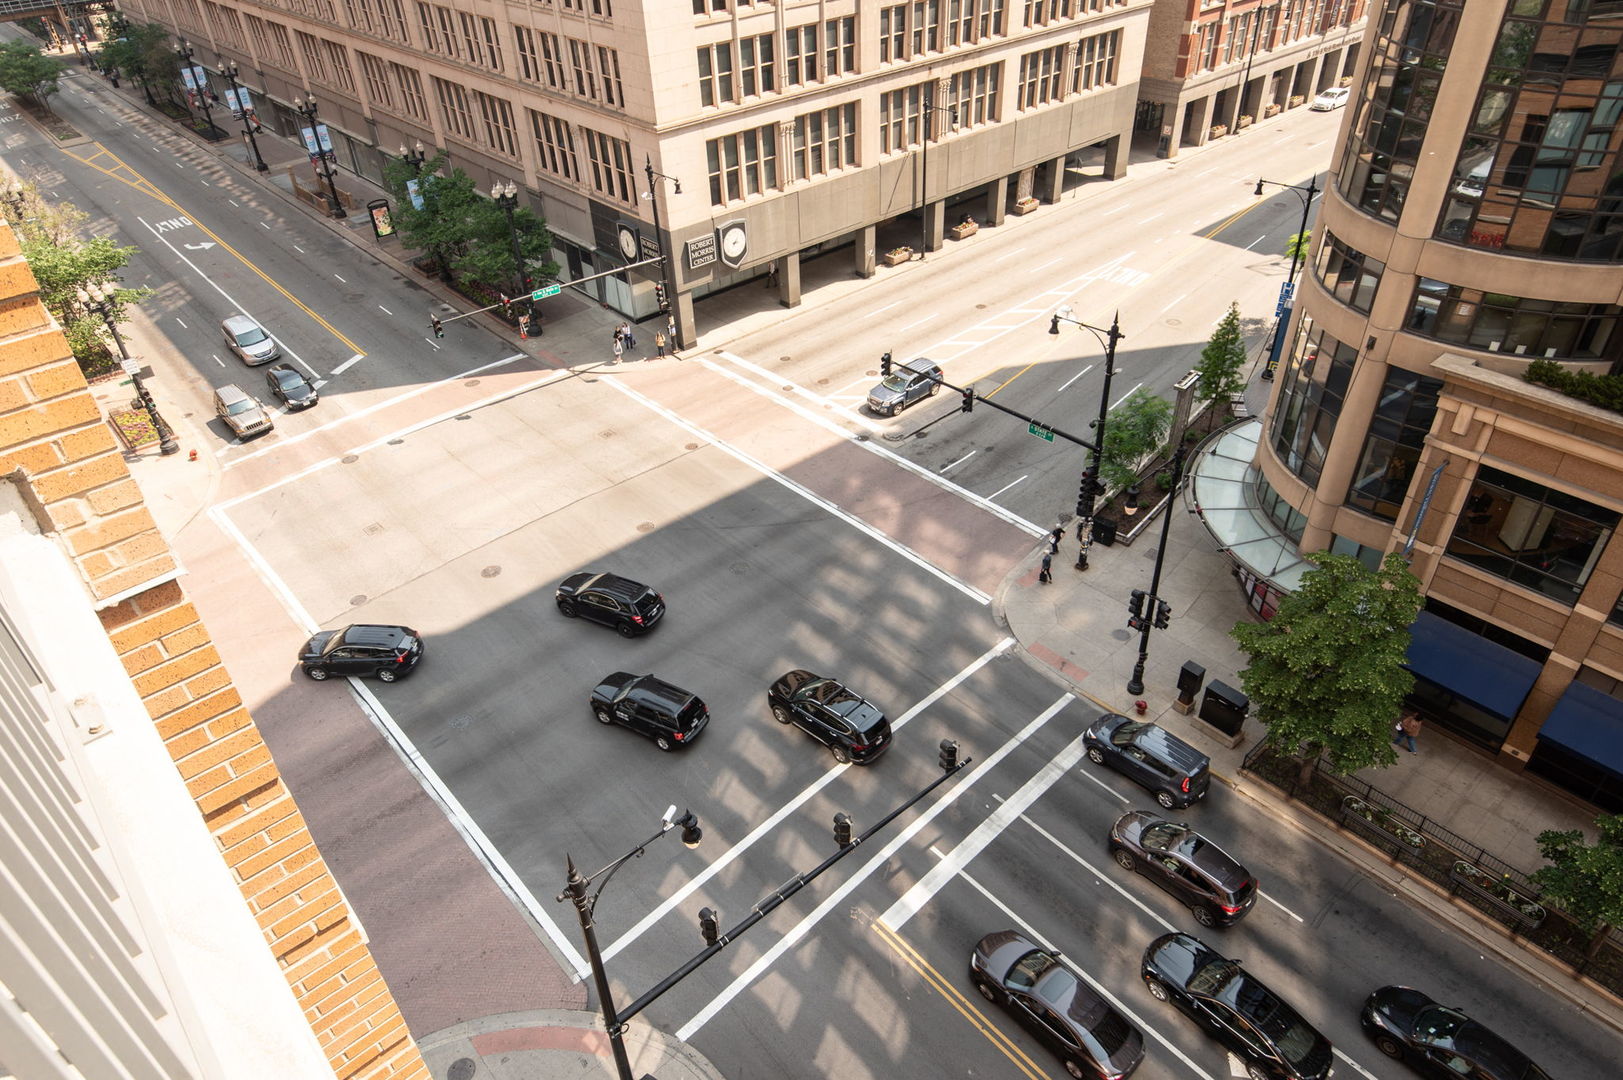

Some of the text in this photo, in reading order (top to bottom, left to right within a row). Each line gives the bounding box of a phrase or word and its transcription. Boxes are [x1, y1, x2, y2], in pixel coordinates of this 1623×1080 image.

[155, 216, 193, 233] ONLY
[691, 238, 713, 251] ROBERT
[691, 246, 715, 259] MORRIS
[693, 254, 714, 266] CENTER
